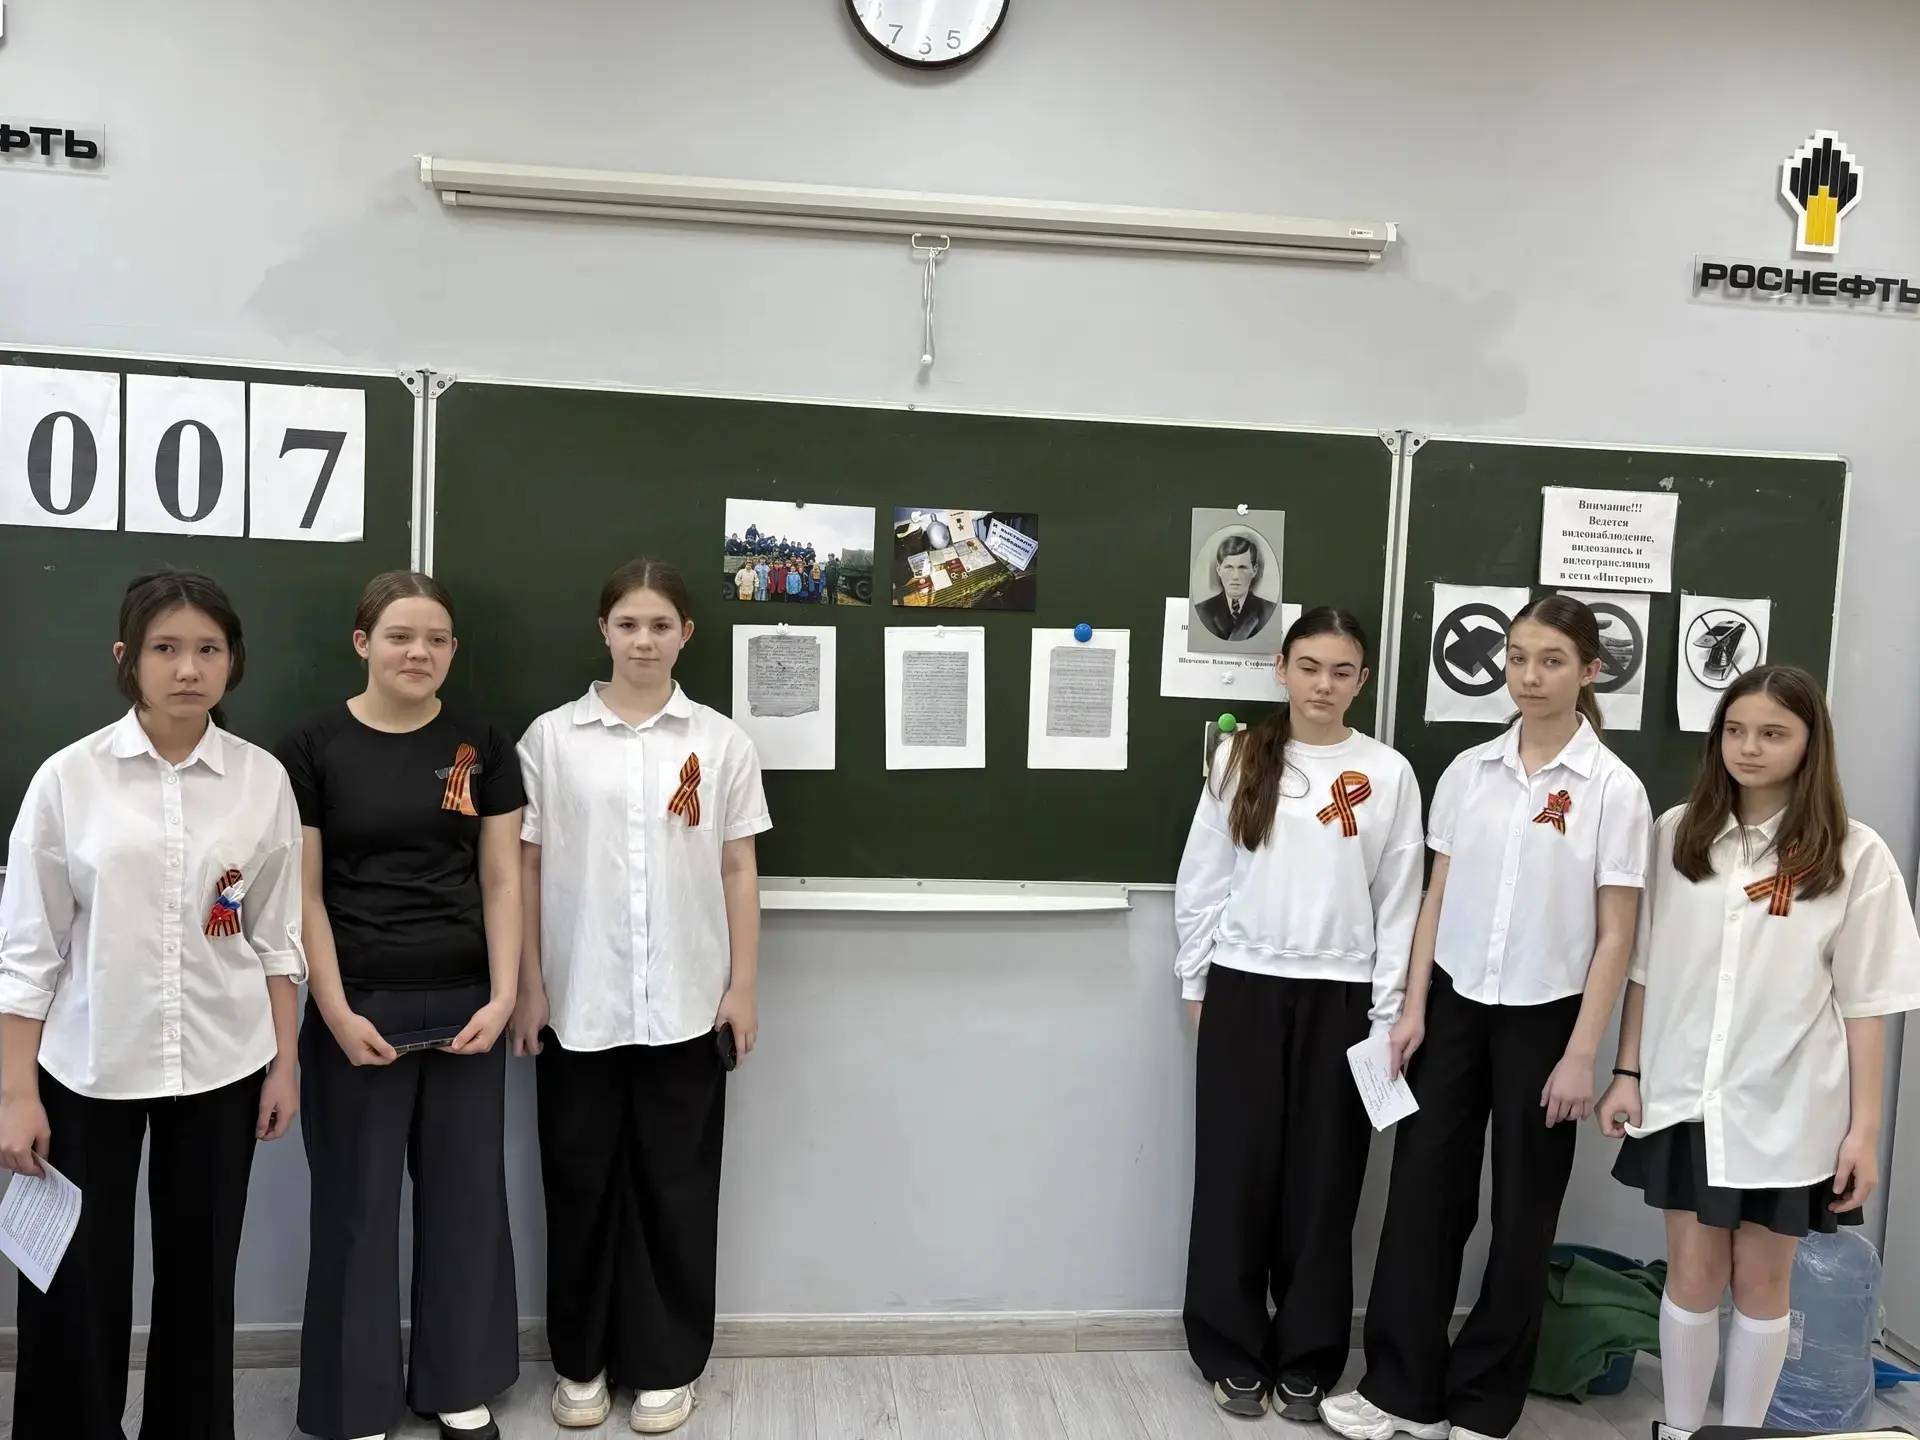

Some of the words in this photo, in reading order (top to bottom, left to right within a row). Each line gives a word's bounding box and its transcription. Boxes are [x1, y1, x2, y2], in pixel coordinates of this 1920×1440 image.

[889, 24, 903, 44] 7
[946, 30, 961, 49] 5
[1701, 262, 1920, 304] РОСНЕФТЬ
[1578, 500, 1643, 513] Внимание!!!
[1589, 516, 1629, 527] Ведется
[1562, 529, 1655, 543] видеонаблюдение,
[1571, 544, 1633, 555] видеозапись
[1562, 557, 1651, 569] видеотрансляция
[1568, 572, 1591, 580] сети
[1593, 572, 1654, 585] «Интернет»
[1212, 659, 1242, 667] Владимир
